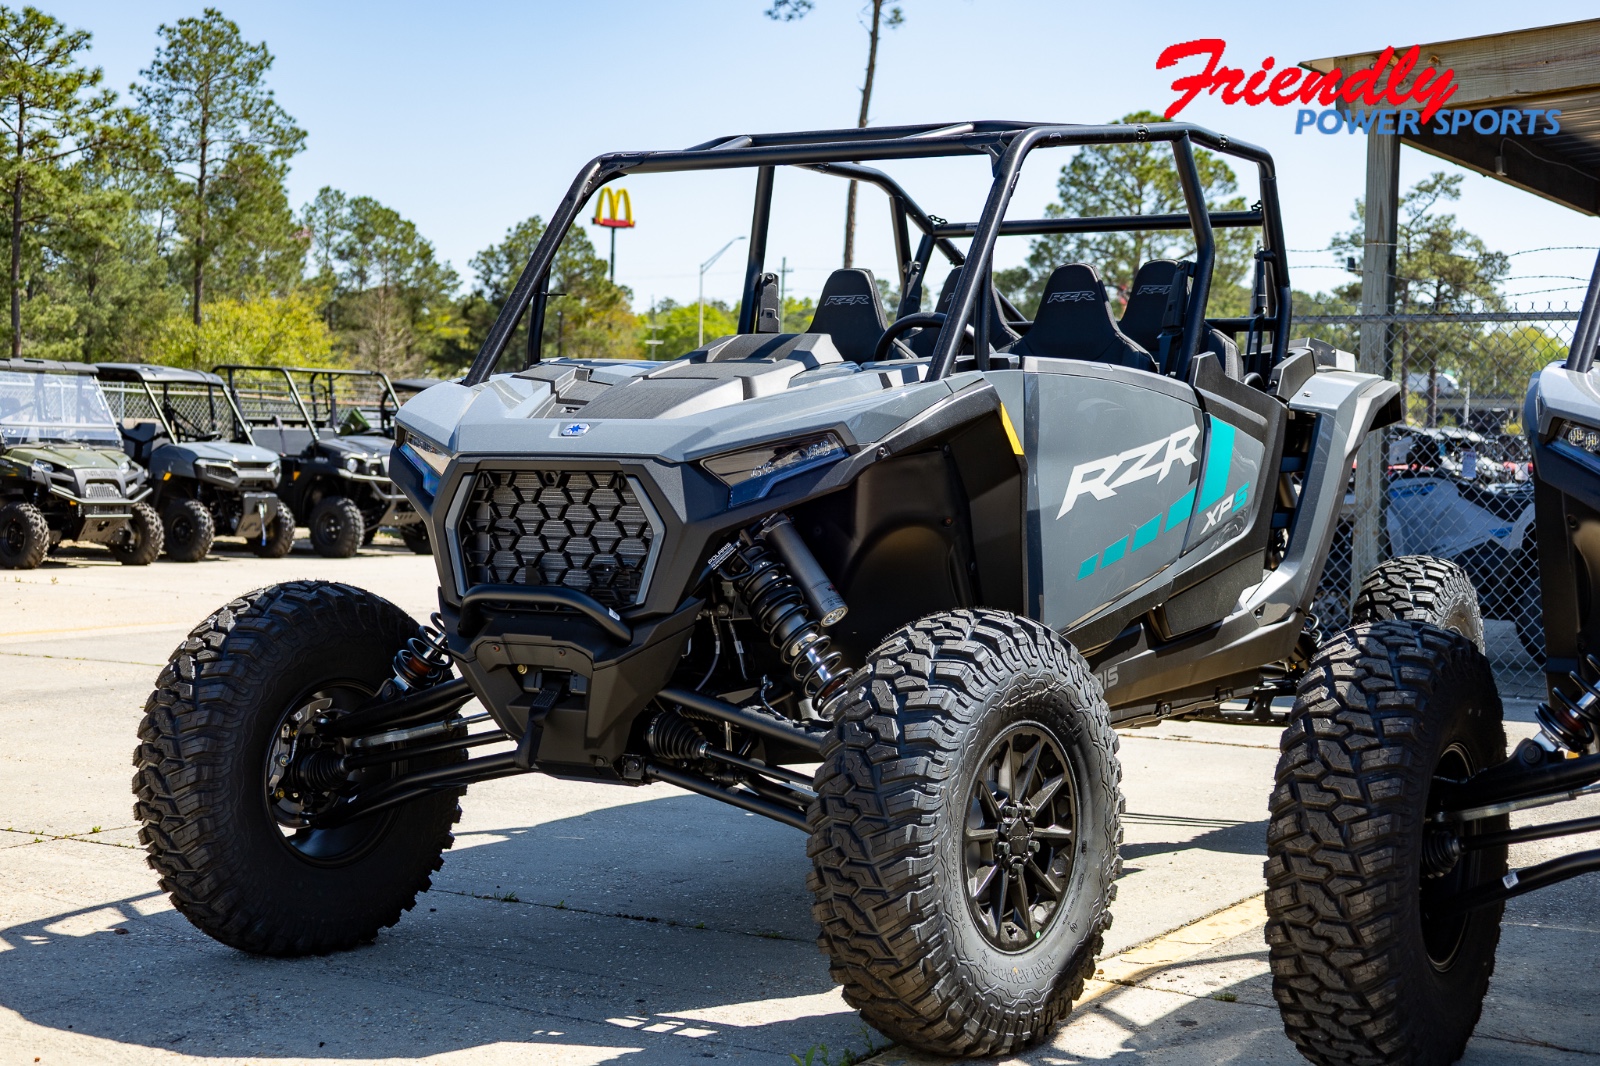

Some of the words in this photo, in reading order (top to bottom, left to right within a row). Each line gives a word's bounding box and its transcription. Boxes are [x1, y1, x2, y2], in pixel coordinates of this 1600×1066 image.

[824, 294, 870, 306] RZR
[1047, 290, 1096, 304] RZR
[1056, 424, 1200, 521] RZR
[707, 541, 732, 565] POLARIS
